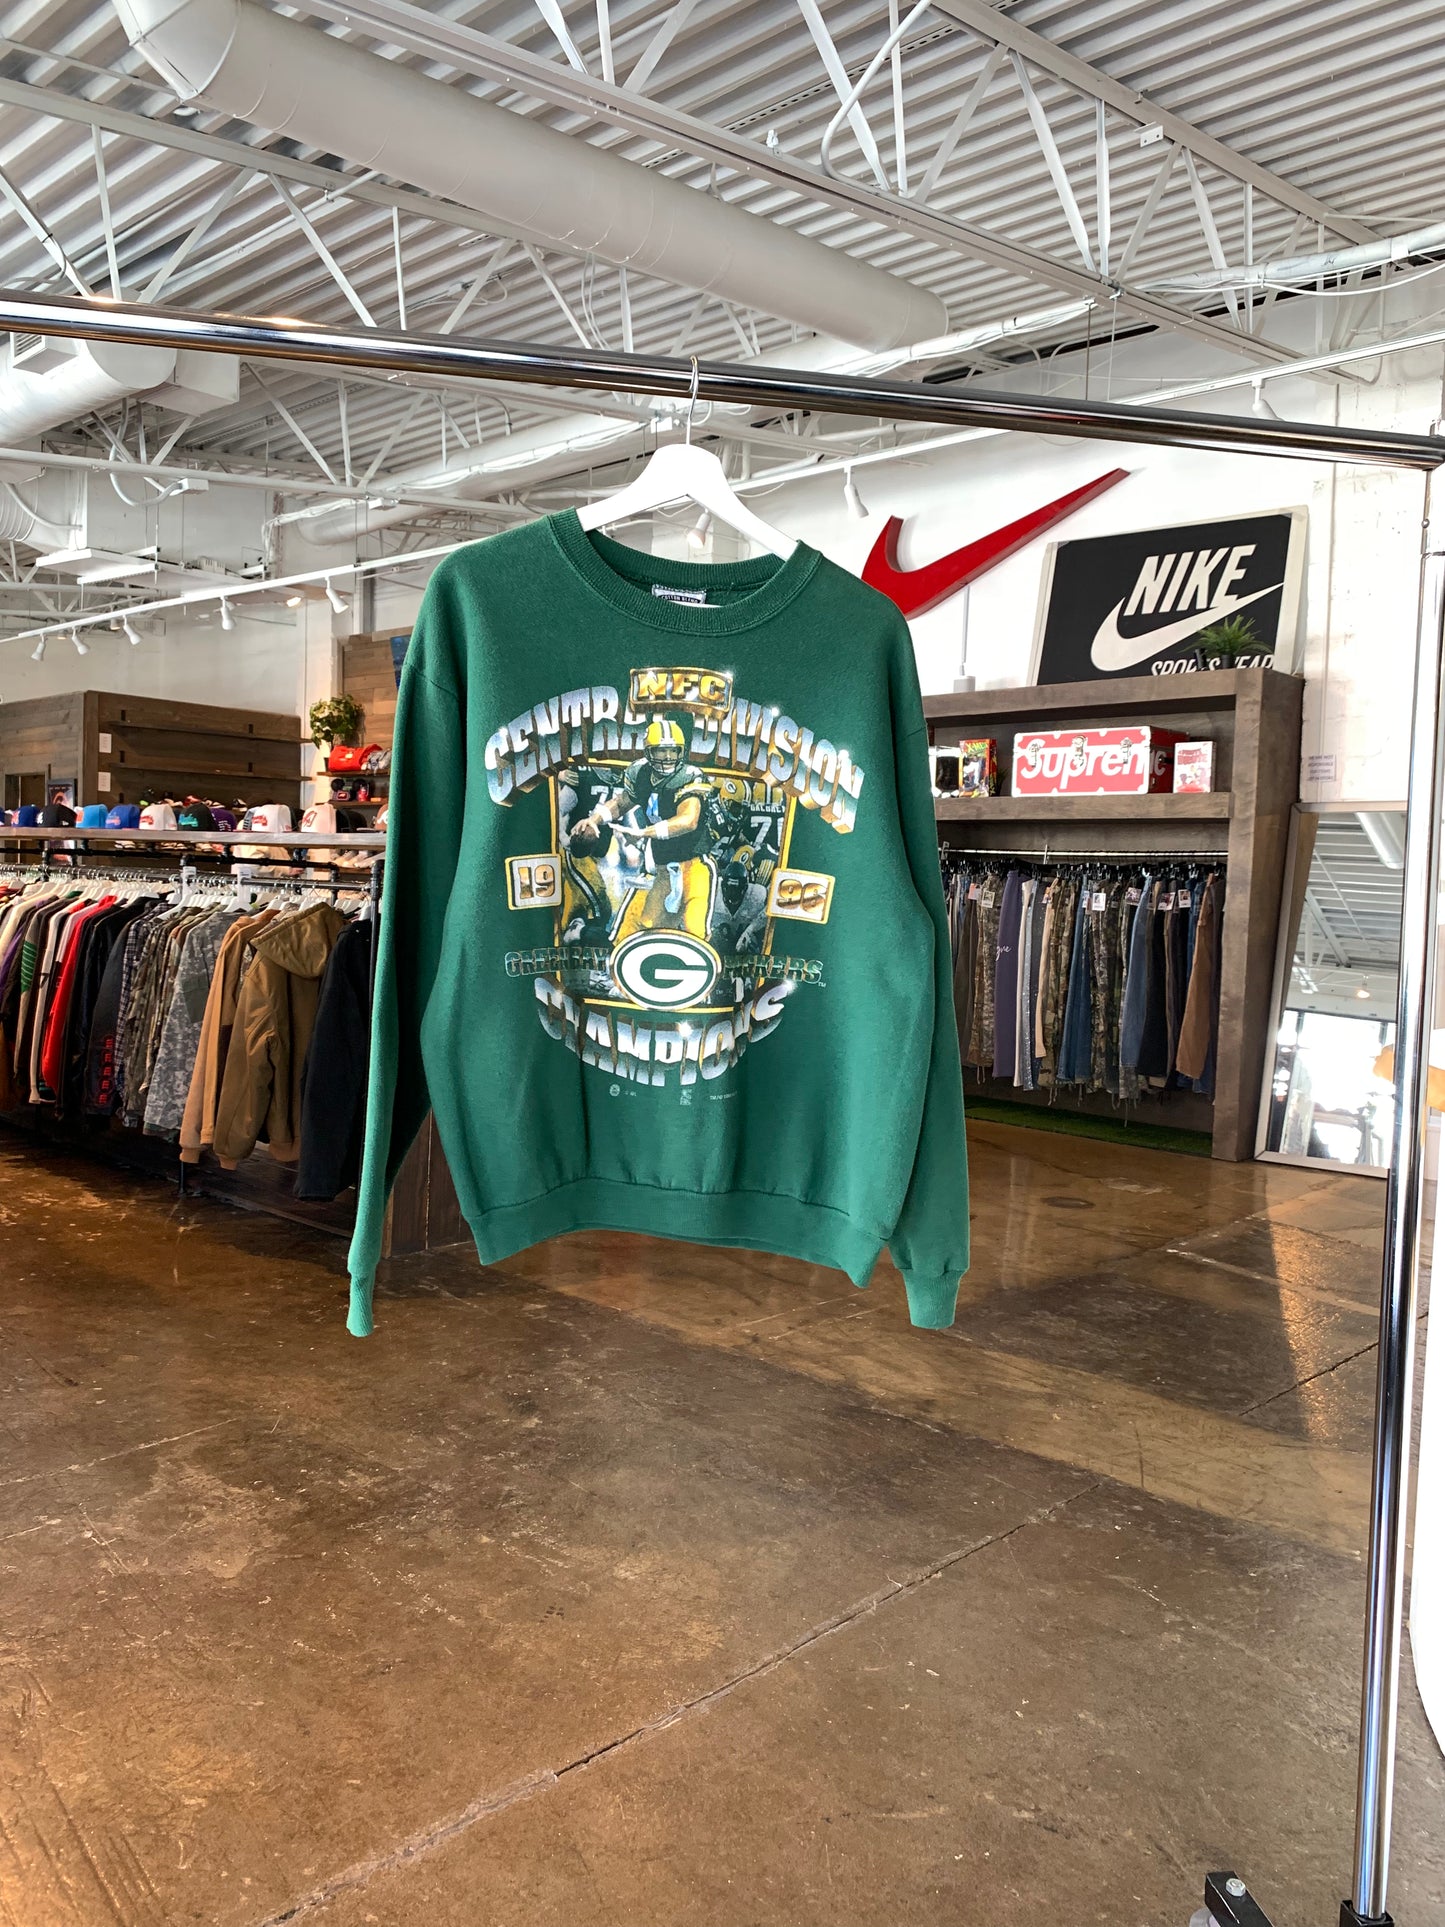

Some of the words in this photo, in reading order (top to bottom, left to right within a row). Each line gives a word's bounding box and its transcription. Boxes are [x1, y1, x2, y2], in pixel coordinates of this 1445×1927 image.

[1123, 543, 1258, 617] NIKE
[637, 670, 728, 703] NFC
[485, 685, 666, 806] CENTRA
[518, 864, 555, 899] 19
[776, 878, 826, 915] 96
